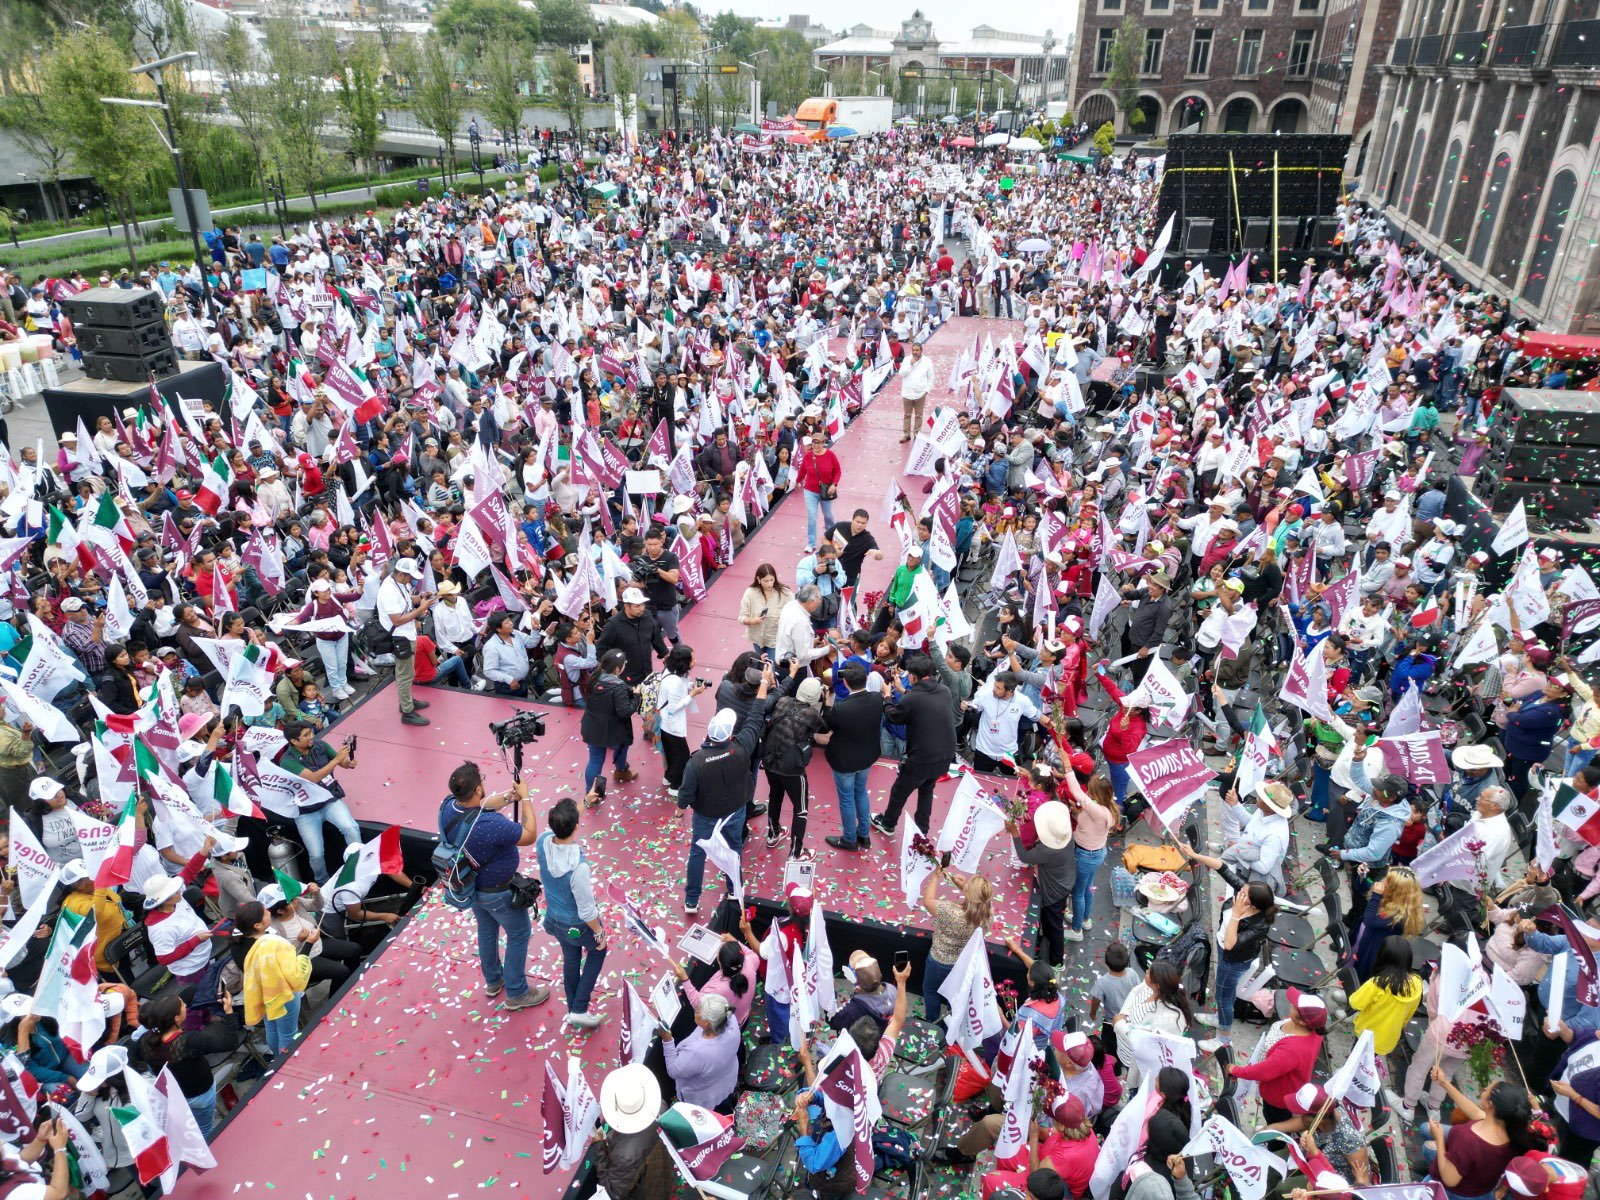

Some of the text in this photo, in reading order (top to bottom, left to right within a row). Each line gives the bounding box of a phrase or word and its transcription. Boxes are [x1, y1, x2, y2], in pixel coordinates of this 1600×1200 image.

[311, 293, 332, 303] RAYON
[912, 442, 931, 472] morena
[1140, 747, 1200, 785] SOMOS 4T
